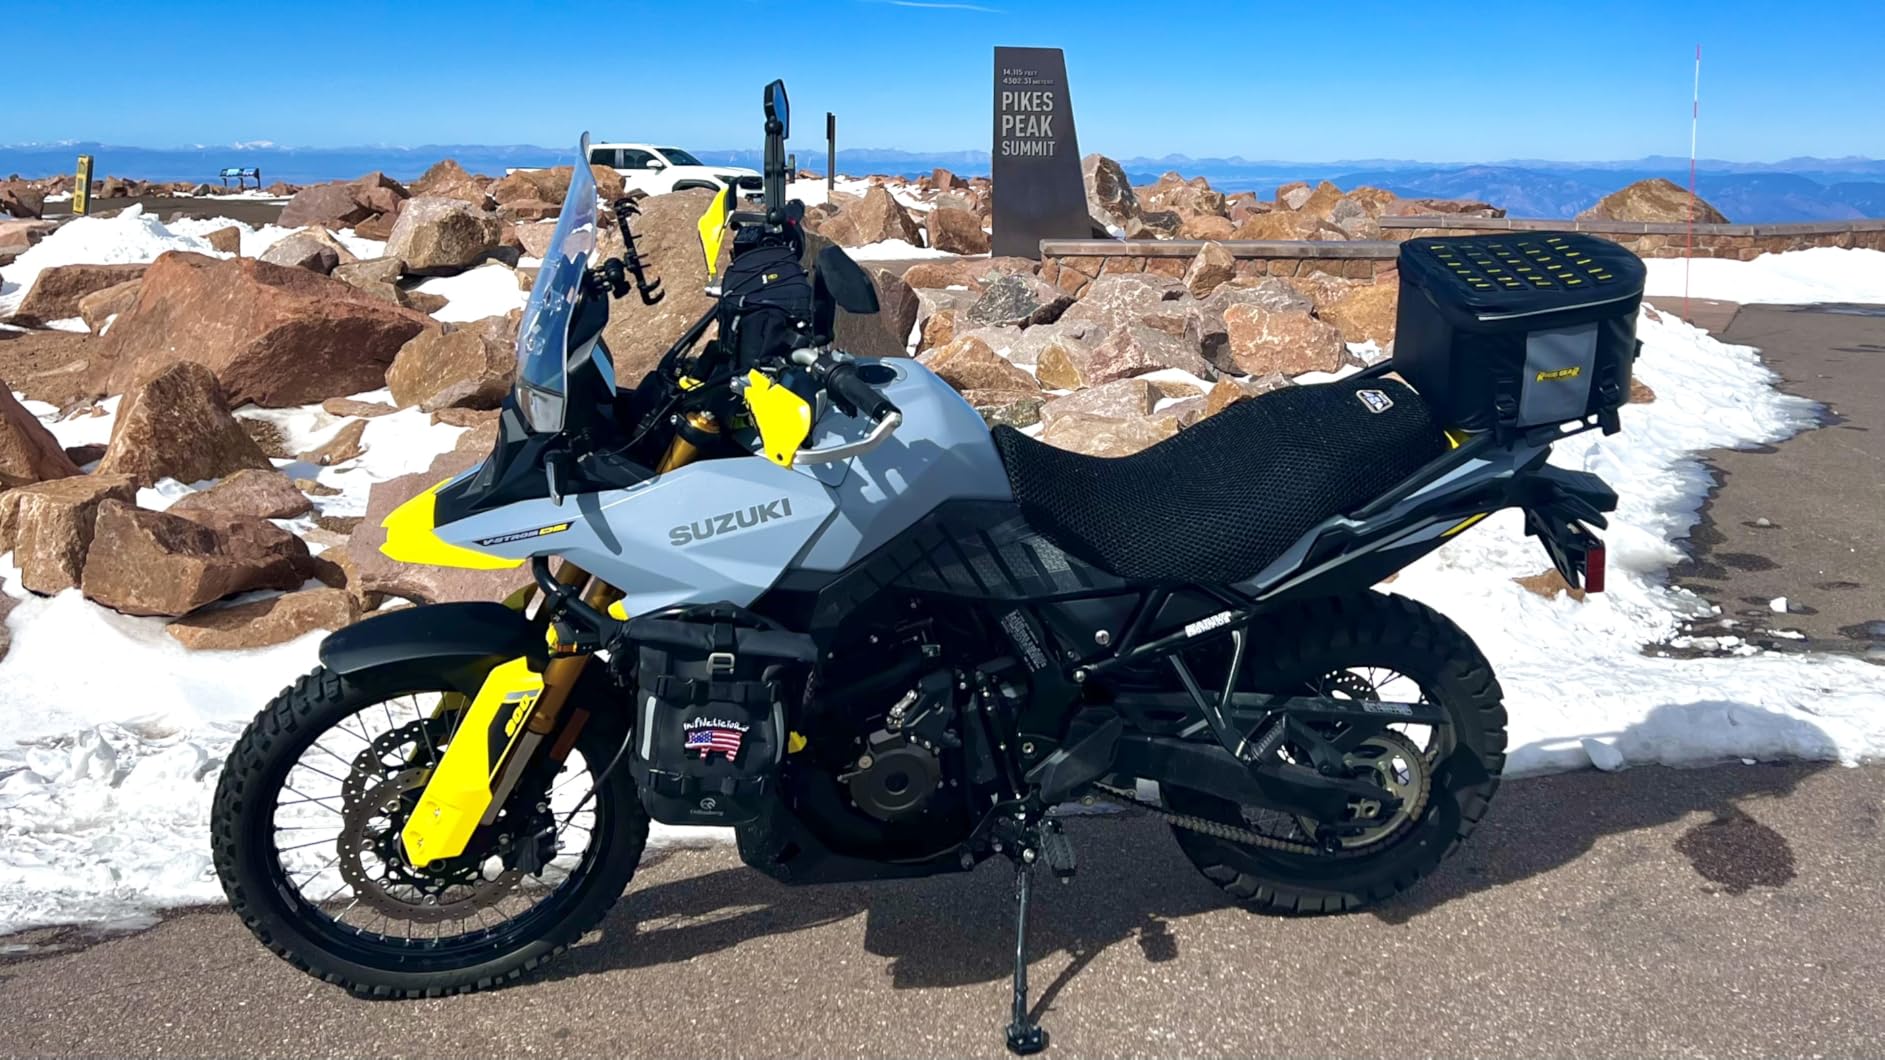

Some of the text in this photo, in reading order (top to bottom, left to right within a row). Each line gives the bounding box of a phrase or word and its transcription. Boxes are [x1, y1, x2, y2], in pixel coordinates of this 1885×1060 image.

[1002, 91, 1053, 111] PIKES
[1002, 115, 1053, 137] PEAK
[1001, 141, 1055, 156] SUMMIT
[668, 498, 792, 546] SUZUKI
